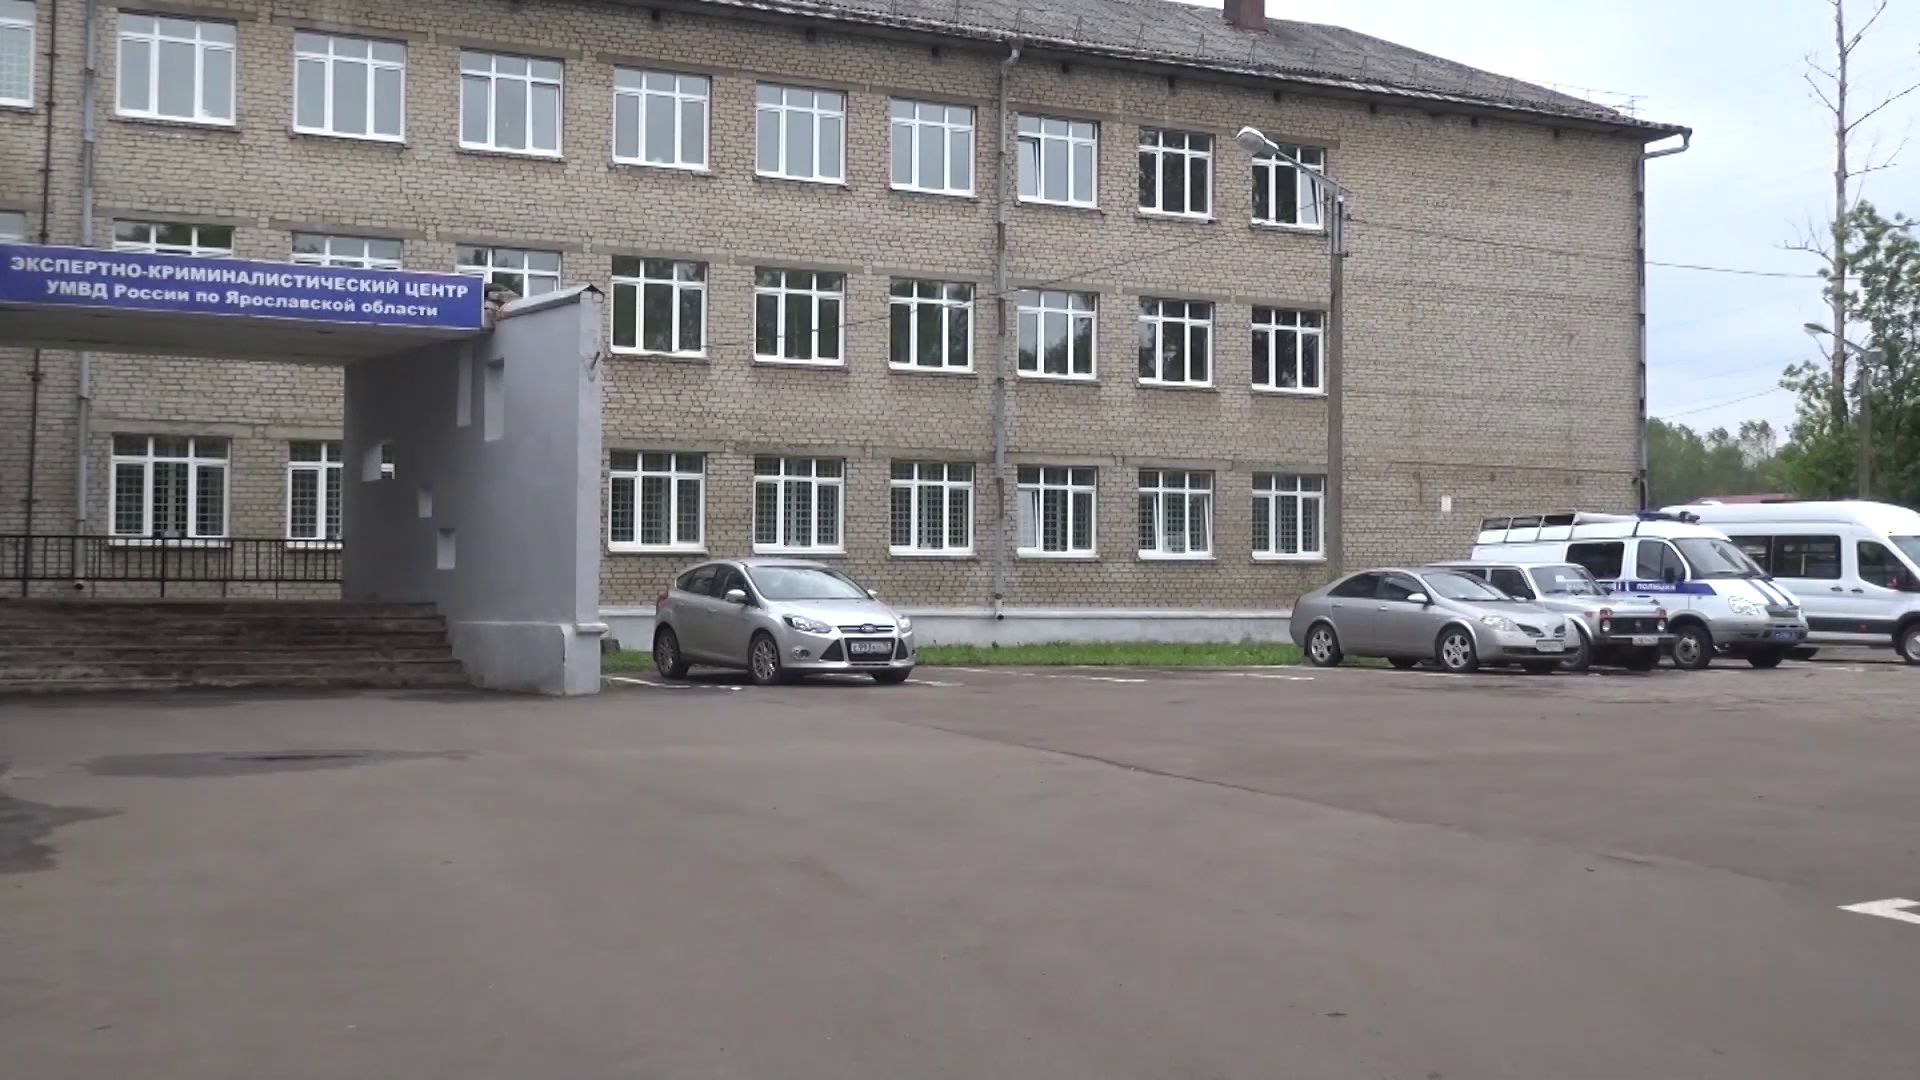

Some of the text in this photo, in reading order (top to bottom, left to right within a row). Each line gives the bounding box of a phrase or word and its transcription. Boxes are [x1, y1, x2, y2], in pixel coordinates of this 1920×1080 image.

[10, 256, 468, 299] ЭКСПЕРТНО-КРИМИНАЛИСТИЧЕСКИЙ ЦЕНТР
[47, 279, 438, 317] УМВД России по Ярославской области
